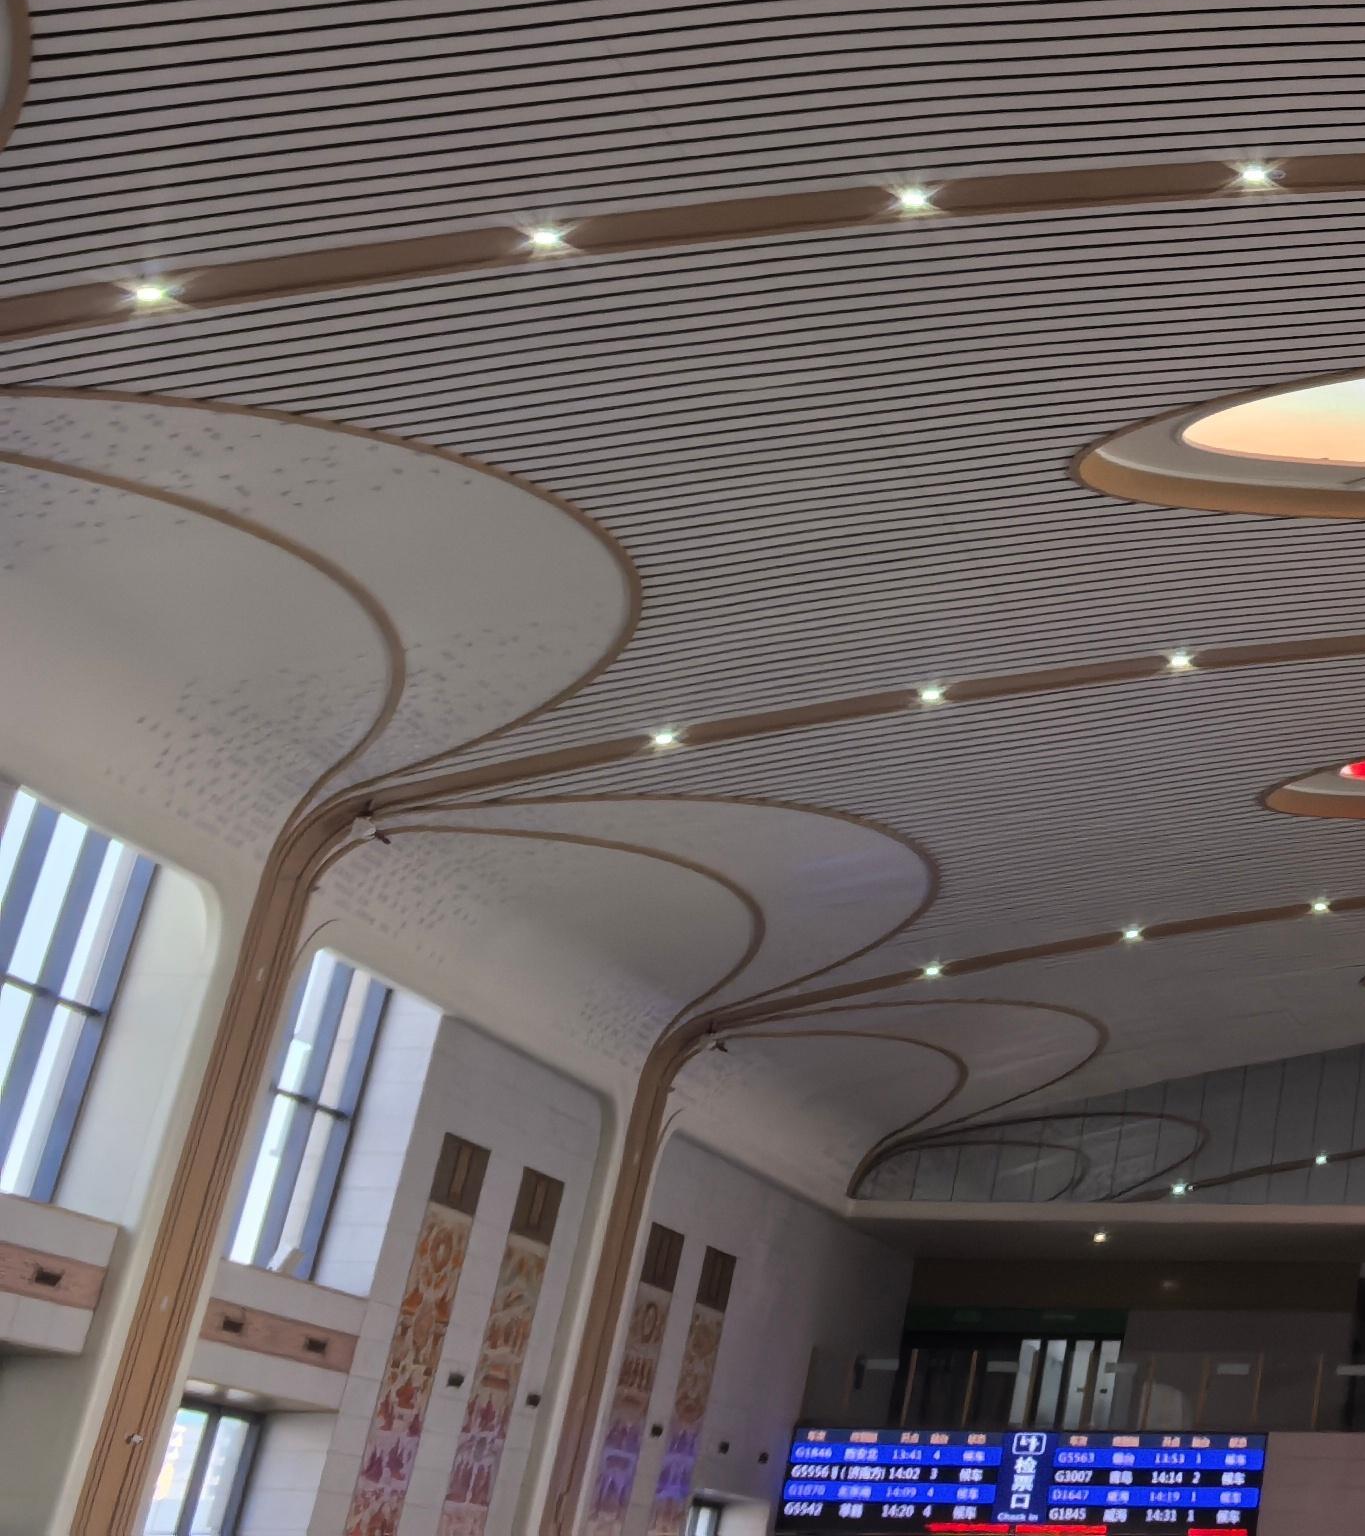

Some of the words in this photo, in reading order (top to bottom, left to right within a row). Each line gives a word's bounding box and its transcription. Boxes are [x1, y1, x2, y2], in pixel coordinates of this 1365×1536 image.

[888, 1467, 921, 1480] 14:02
[1151, 1471, 1182, 1484] 14:14
[1010, 1455, 1038, 1510] 检票口
[922, 1504, 933, 1518] 4
[1049, 1507, 1087, 1521] G1845
